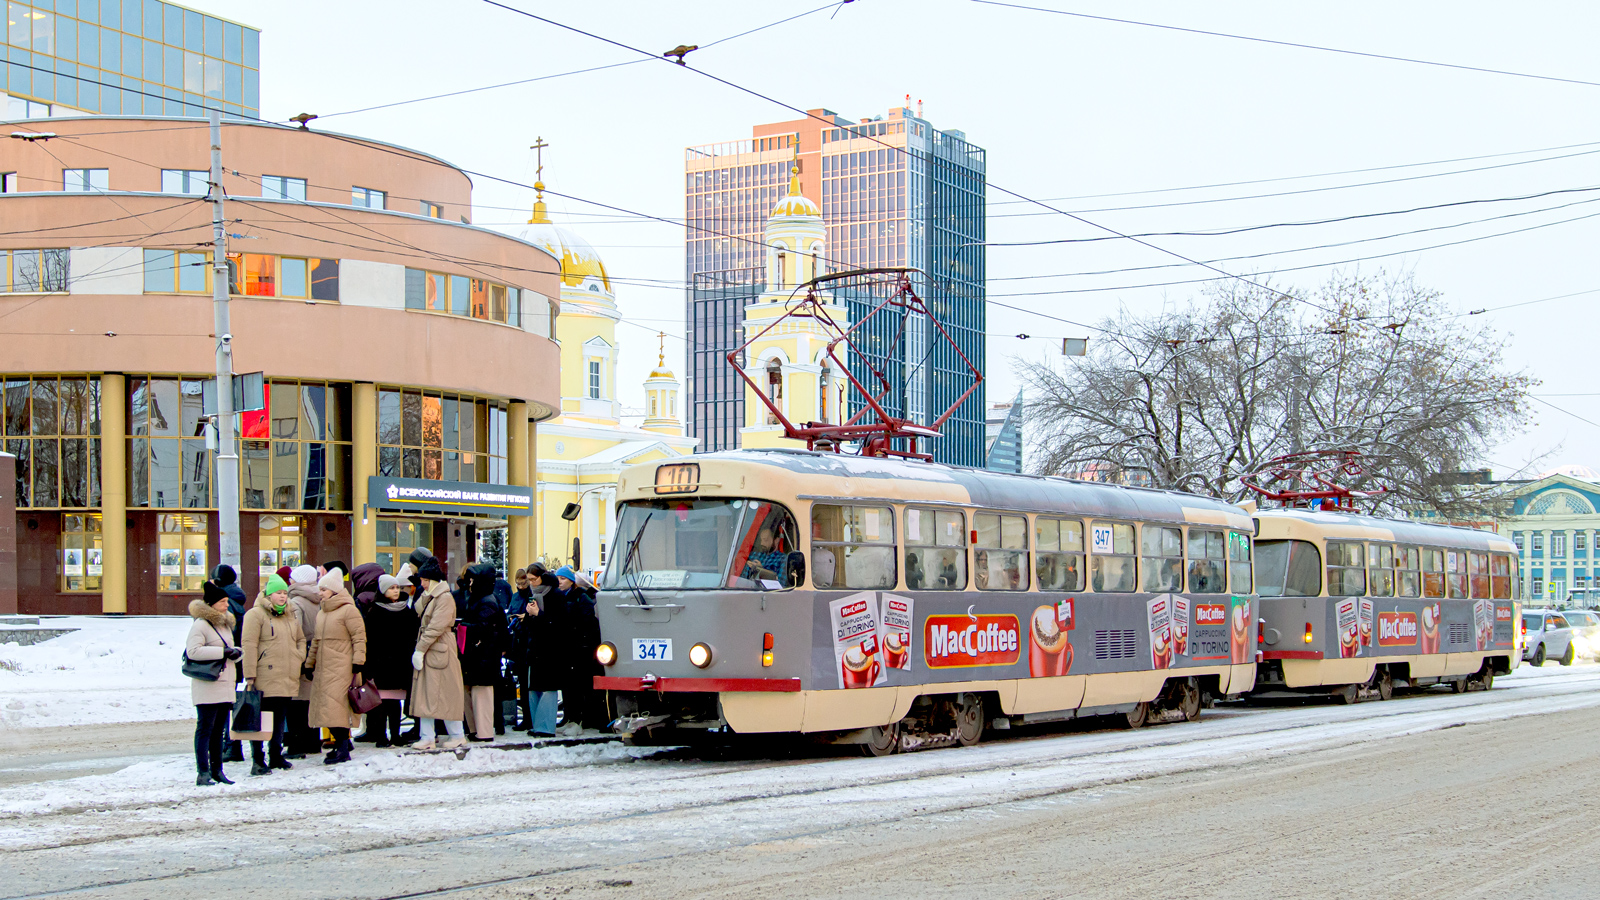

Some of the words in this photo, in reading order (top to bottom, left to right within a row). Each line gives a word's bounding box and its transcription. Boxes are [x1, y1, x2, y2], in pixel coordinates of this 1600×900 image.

[398, 487, 461, 499] ВСЕРОССИЙСКИЙ
[462, 491, 479, 501] БАНК
[479, 492, 506, 502] РАЗВИТИЯ
[507, 494, 530, 504] РЕГИОНОВ
[1095, 529, 1110, 546] 347
[842, 602, 866, 616] MacCoffee
[887, 611, 908, 619] CAPPUCCINO
[1197, 607, 1225, 621] MacCoffee
[841, 613, 871, 627] CAPPUCCINO
[884, 615, 890, 623] DI
[891, 617, 910, 627] TORINO
[837, 629, 845, 638] DI
[847, 619, 875, 635] TORINO
[1195, 629, 1226, 638] CAPPUCCINO
[1380, 617, 1417, 639] MacCoffee
[931, 623, 1017, 658] MacCoffee
[1192, 641, 1199, 654] DI
[1201, 641, 1229, 654] TORINO
[638, 643, 668, 659] 347
